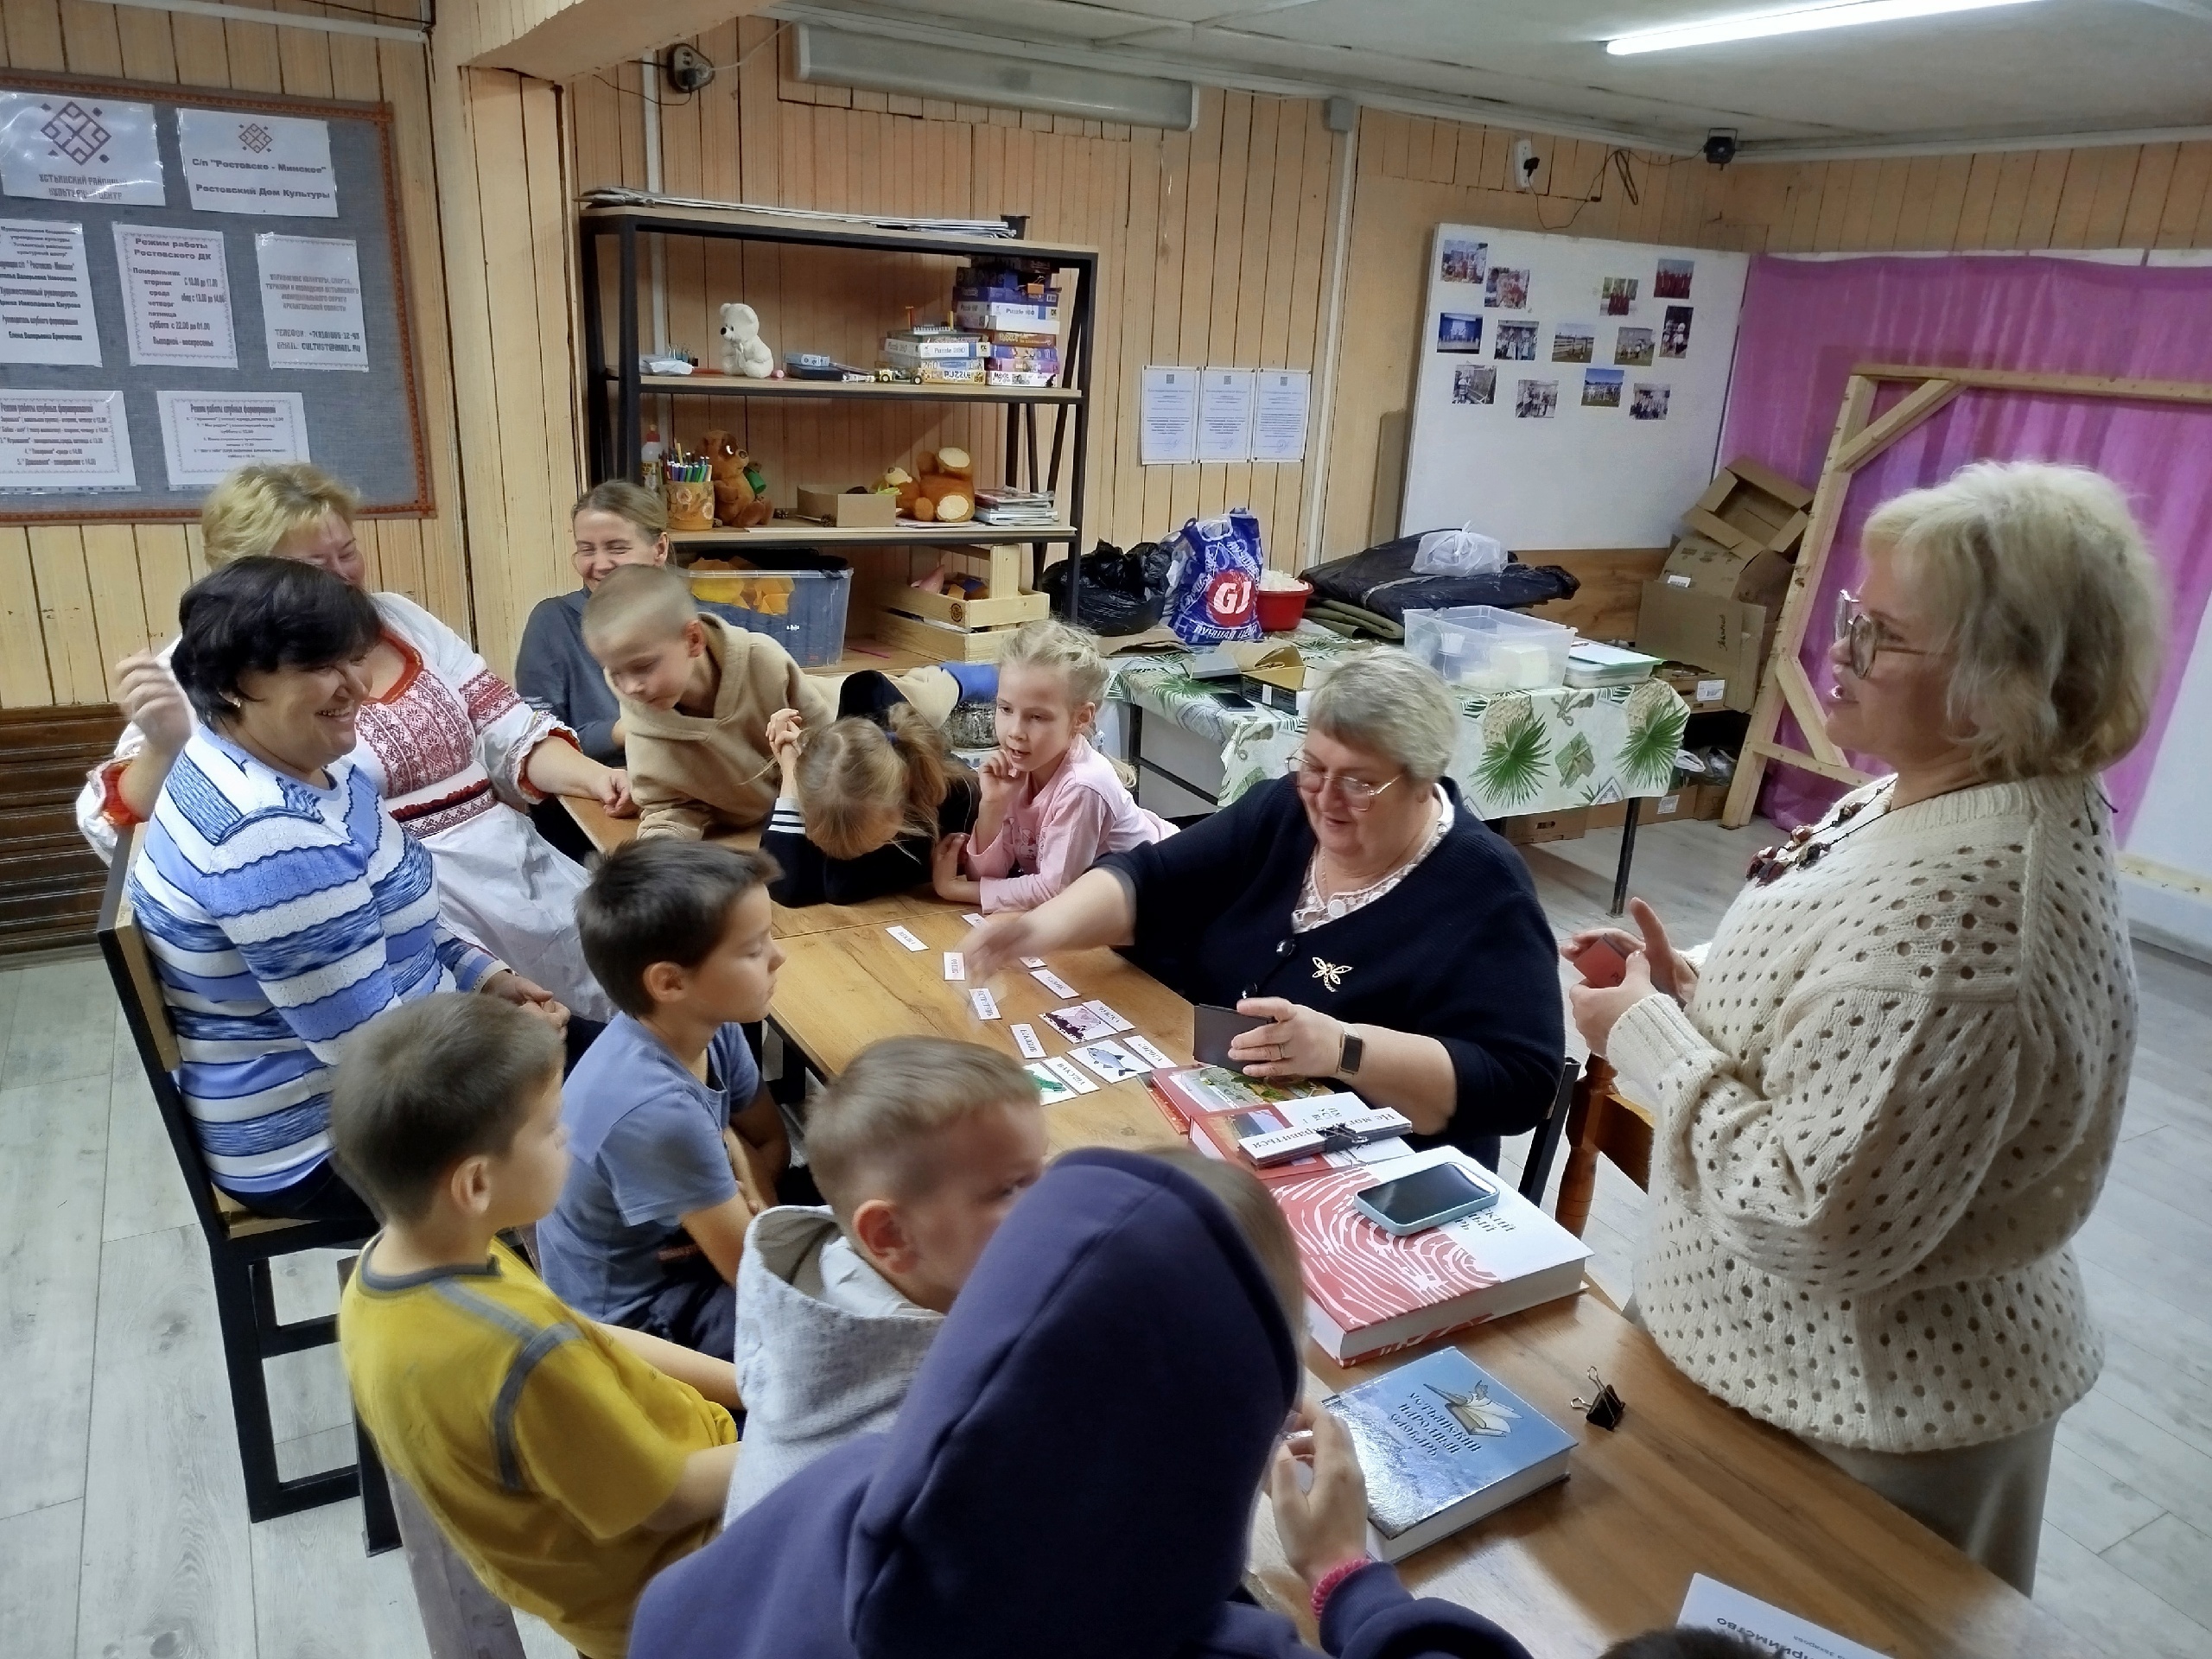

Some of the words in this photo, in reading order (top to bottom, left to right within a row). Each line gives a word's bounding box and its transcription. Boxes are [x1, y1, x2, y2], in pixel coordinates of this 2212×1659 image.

[192, 158, 208, 167] С/п
[211, 159, 270, 170] "Ростовско
[277, 163, 327, 174] Минское"
[195, 183, 257, 195] Ростовский
[258, 188, 281, 197] Дом
[283, 189, 330, 200] Культуры
[135, 238, 169, 246] Режим
[134, 249, 195, 259] Ростовского
[133, 267, 181, 276] Понедельник
[149, 321, 168, 329] суббота
[1376, 1113, 1396, 1122] Не
[1399, 1403, 1461, 1453] НАРОДНЫЙ
[1409, 1392, 1482, 1452] УСТЬЯНСКИЙ
[1390, 1414, 1438, 1456] СЛОВАРЬ
